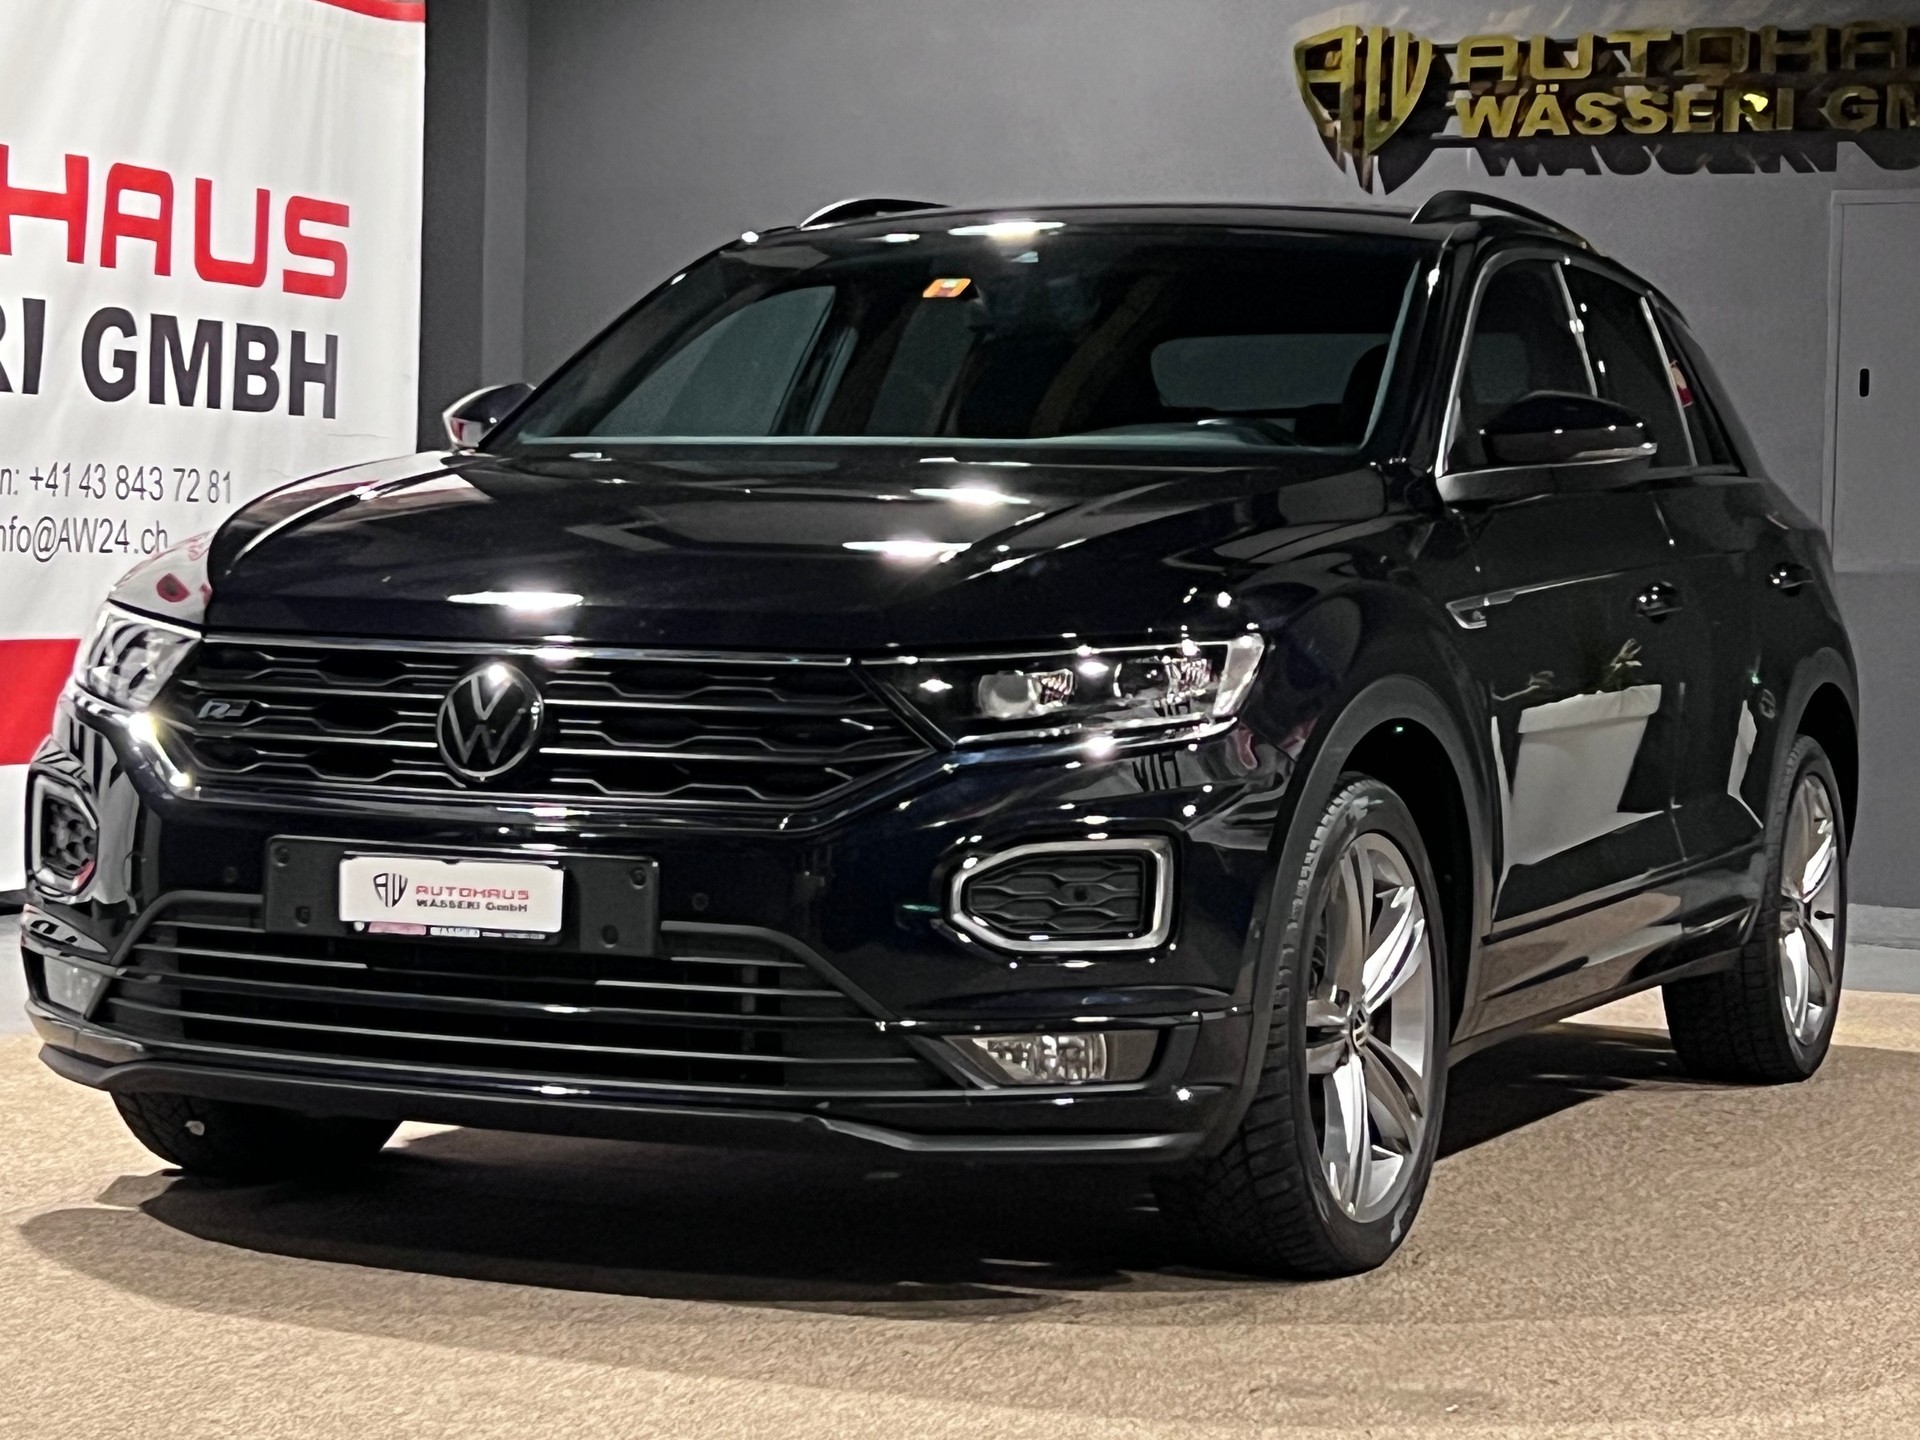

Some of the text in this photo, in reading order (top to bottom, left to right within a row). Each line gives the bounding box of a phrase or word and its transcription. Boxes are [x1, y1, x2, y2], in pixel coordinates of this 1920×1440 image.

[1456, 84, 1795, 138] WÄSSERI
[0, 143, 350, 300] HAUS
[82, 307, 339, 420] GMBH
[29, 462, 72, 498] +41
[79, 463, 107, 499] 43
[115, 465, 164, 501] 843
[173, 468, 201, 502] 72
[207, 469, 231, 503] 81
[415, 885, 530, 901] AUTOHAUS
